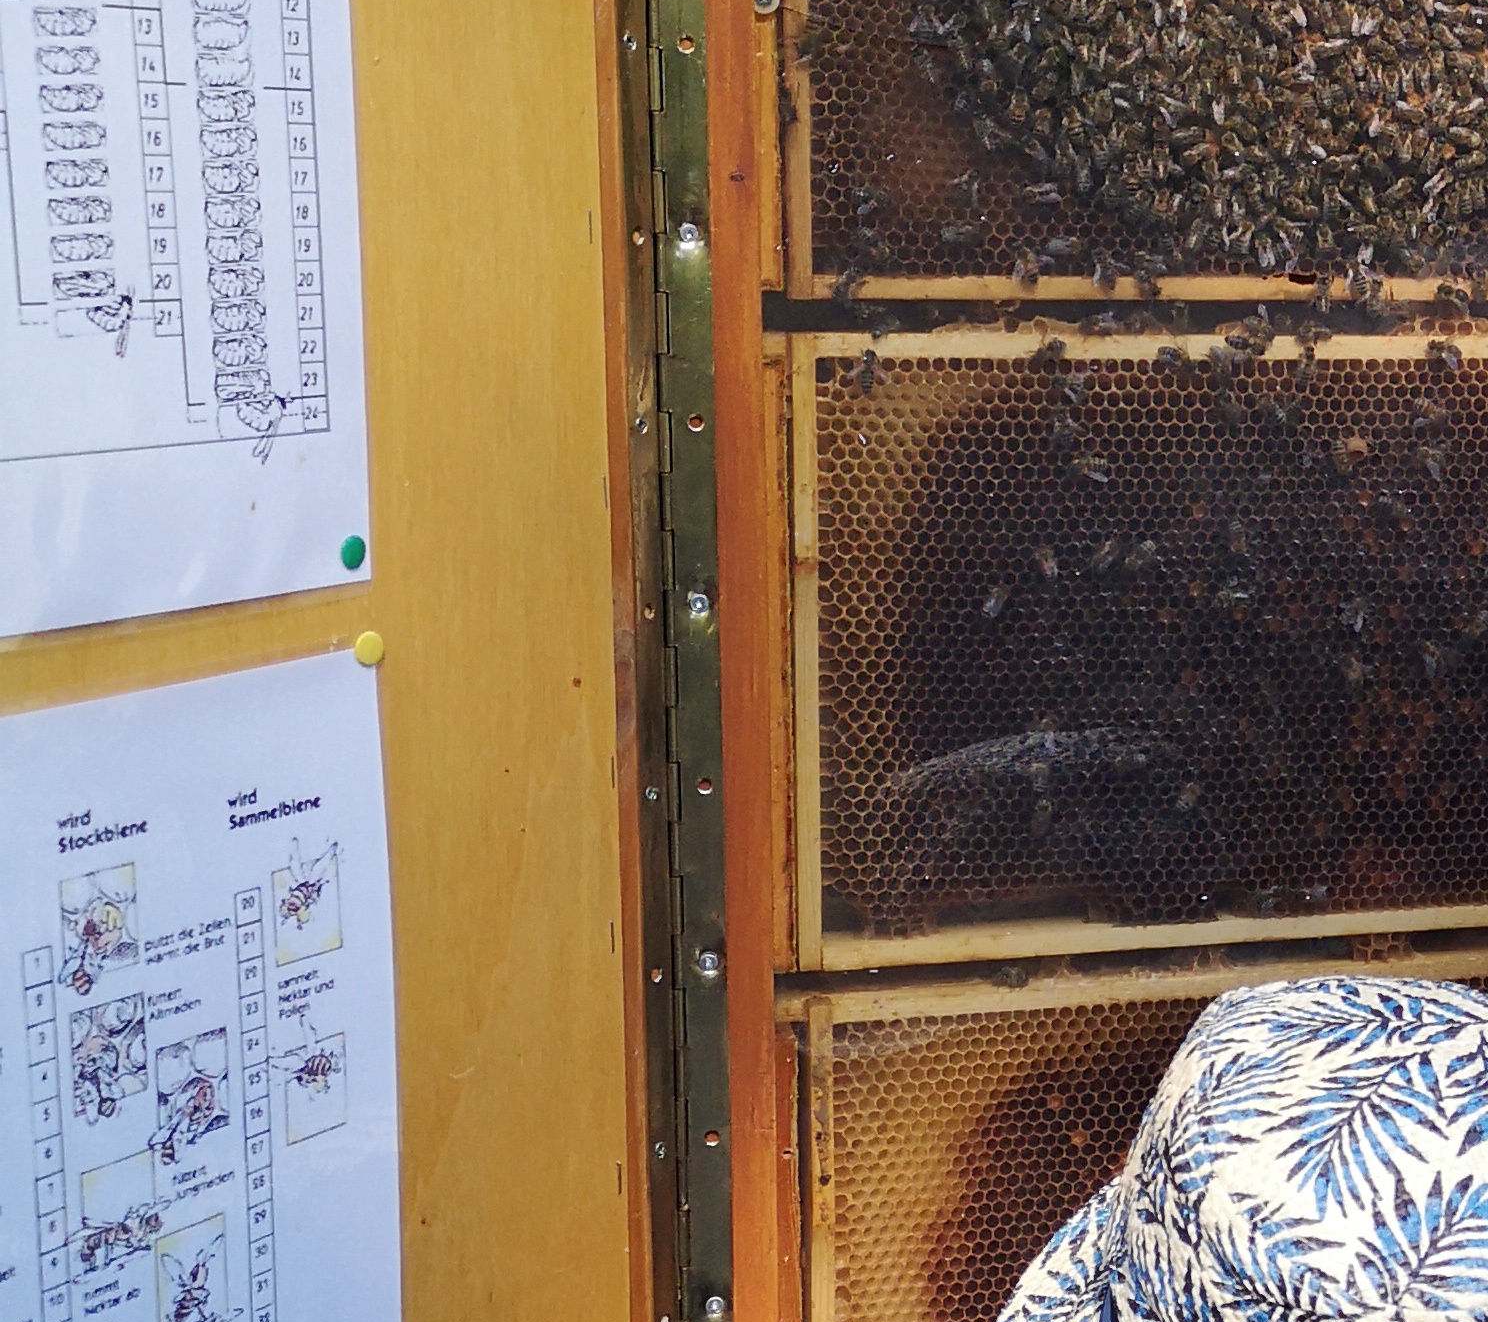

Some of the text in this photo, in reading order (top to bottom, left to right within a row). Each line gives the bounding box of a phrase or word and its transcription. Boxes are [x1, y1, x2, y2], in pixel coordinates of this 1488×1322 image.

[138, 19, 152, 35] 13
[287, 31, 300, 46] 13
[142, 56, 156, 72] 14
[289, 67, 302, 81] 14
[143, 93, 158, 108] 15
[291, 100, 304, 116] 15
[147, 131, 162, 146] 16
[293, 137, 307, 151] 16
[148, 167, 164, 182] 17
[294, 170, 308, 185] 17
[151, 203, 165, 218] 18
[296, 205, 309, 220] 18
[153, 238, 167, 253] 19
[298, 238, 311, 253] 19
[154, 274, 172, 290] 20
[298, 272, 314, 287] 20
[157, 310, 171, 326] 21
[300, 307, 313, 321] 21
[300, 340, 317, 354] 22
[303, 372, 318, 387] 23
[304, 406, 318, 420] 24
[227, 788, 258, 808] wird
[57, 808, 91, 829] wird
[229, 795, 322, 831] Sammelbiene
[58, 819, 149, 853] Stockbiene
